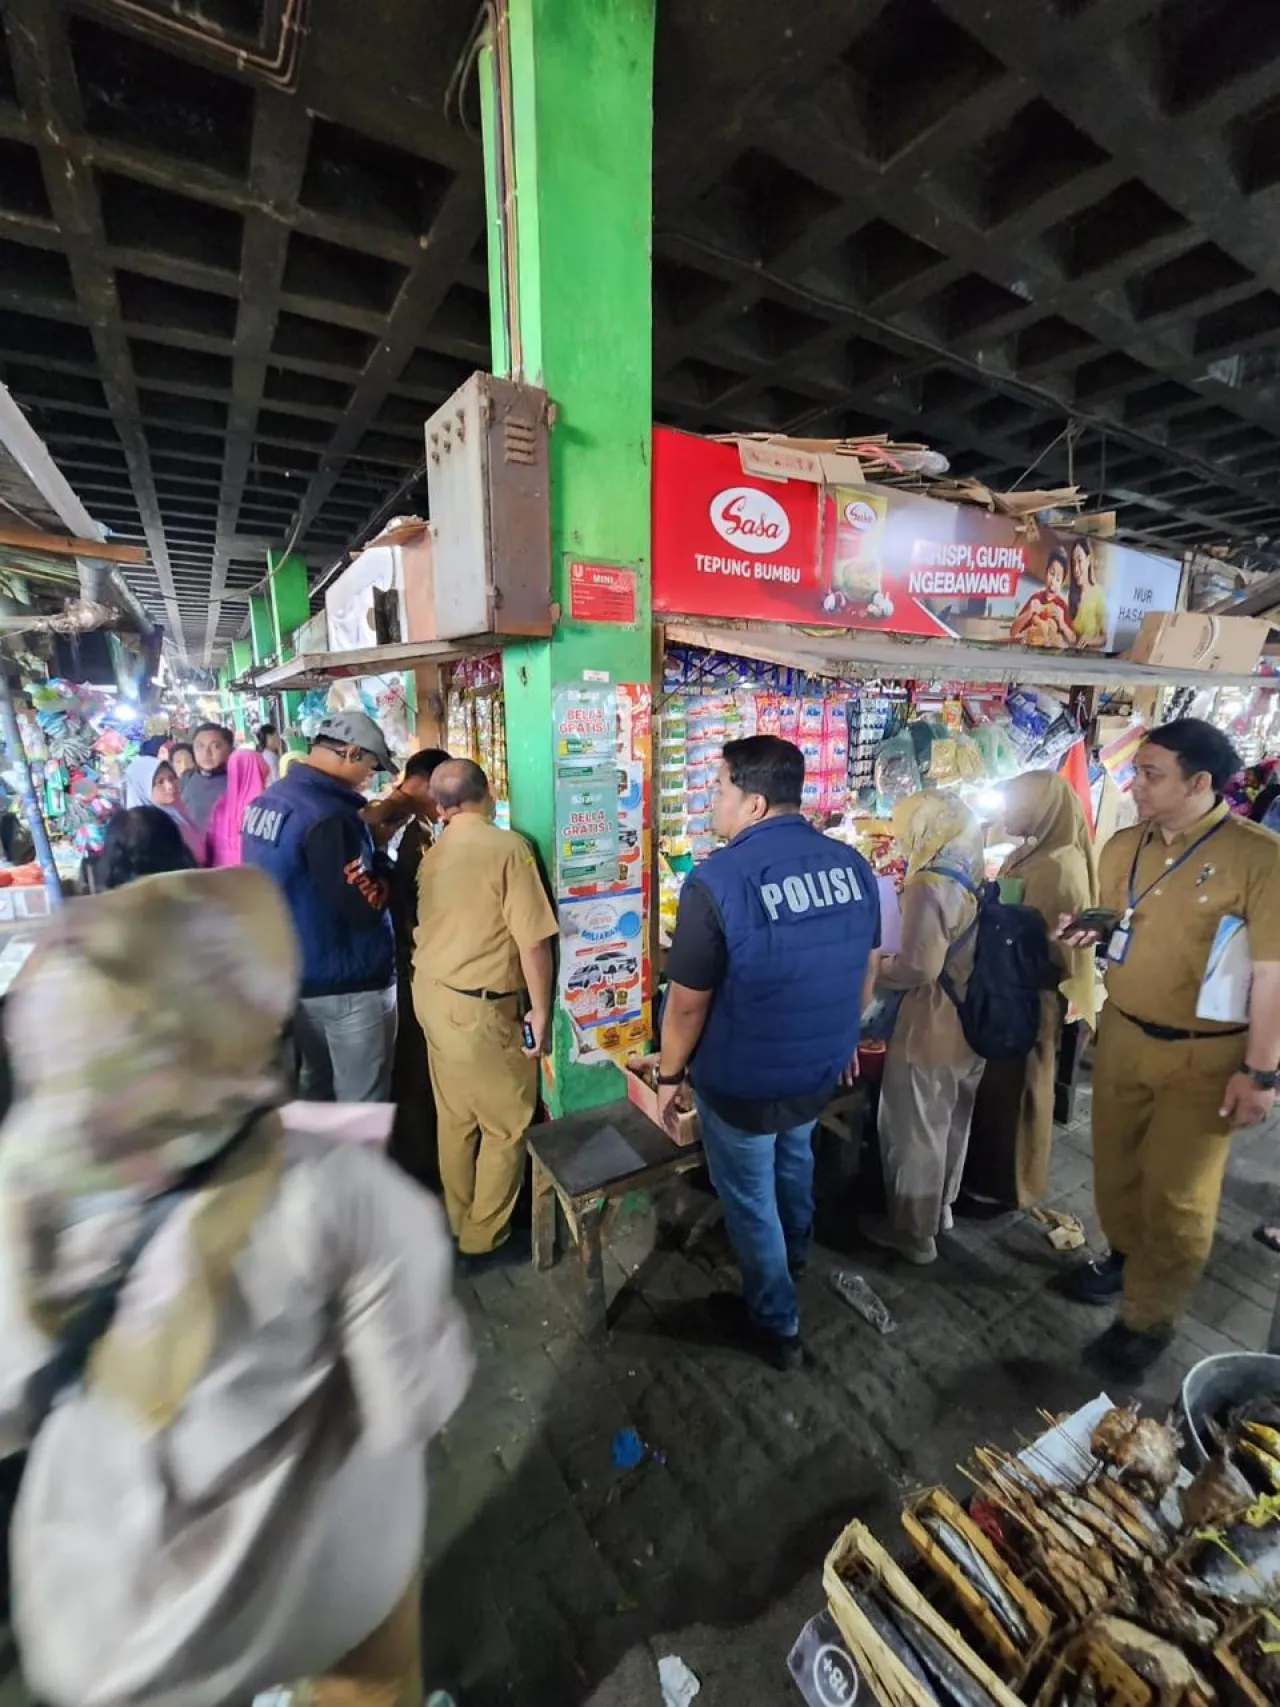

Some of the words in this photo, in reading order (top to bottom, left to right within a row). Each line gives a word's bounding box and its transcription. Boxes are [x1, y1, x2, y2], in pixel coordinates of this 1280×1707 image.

[720, 495, 783, 539] Sasa
[694, 553, 751, 577] TEPUNG
[754, 562, 801, 585] BUMBU
[975, 546, 1025, 573] GURIH,
[907, 571, 1010, 594] NGEBAWANG
[1133, 587, 1153, 604] NUR
[760, 867, 862, 920] POLISI
[823, 1658, 847, 1699] 18+
